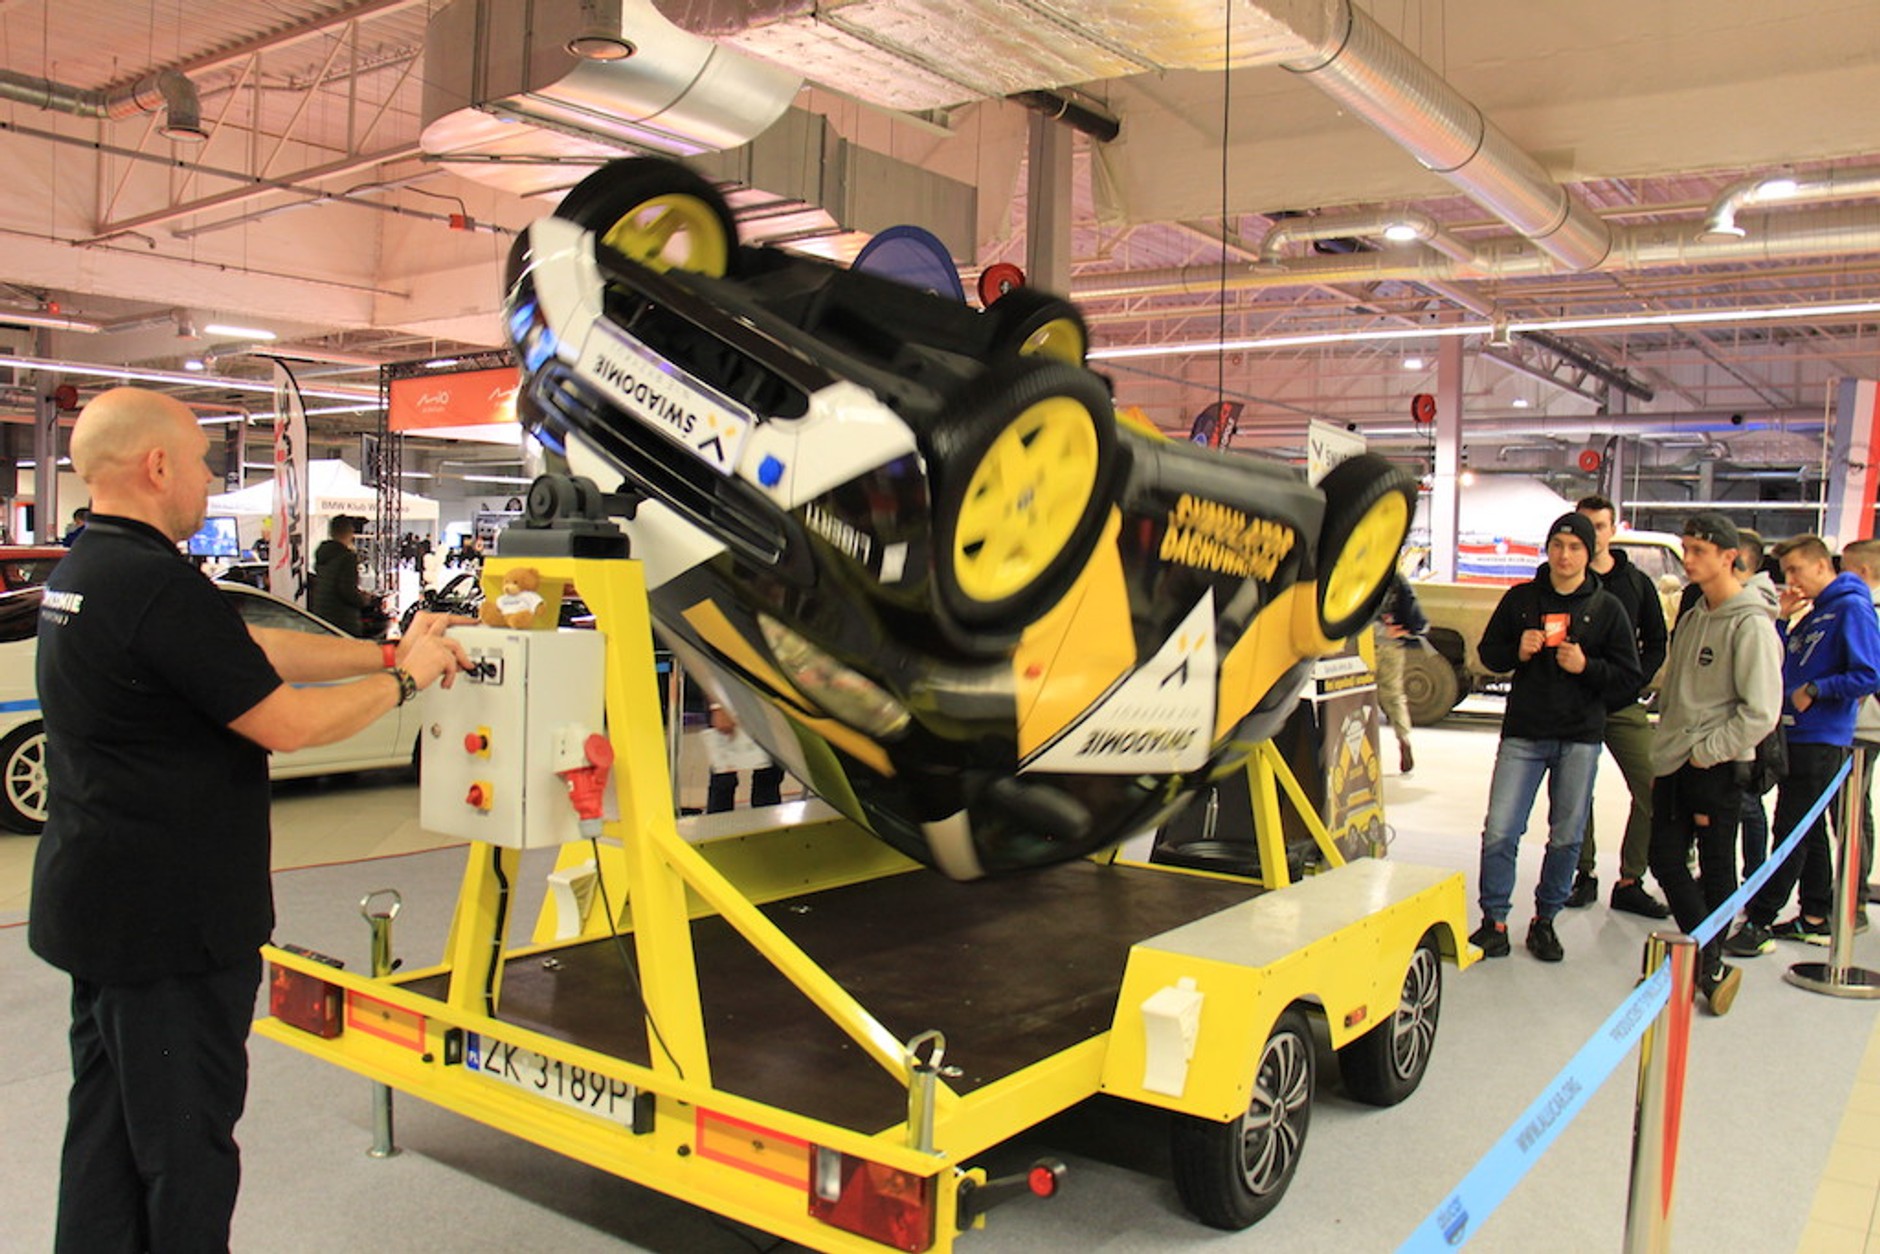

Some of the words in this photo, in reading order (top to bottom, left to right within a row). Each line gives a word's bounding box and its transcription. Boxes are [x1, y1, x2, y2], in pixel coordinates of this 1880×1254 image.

[321, 501, 345, 510] BMW
[347, 502, 366, 511] Klub
[804, 501, 872, 566] LIBERTY
[484, 1041, 520, 1082] ZK
[534, 1053, 628, 1114] 3189P
